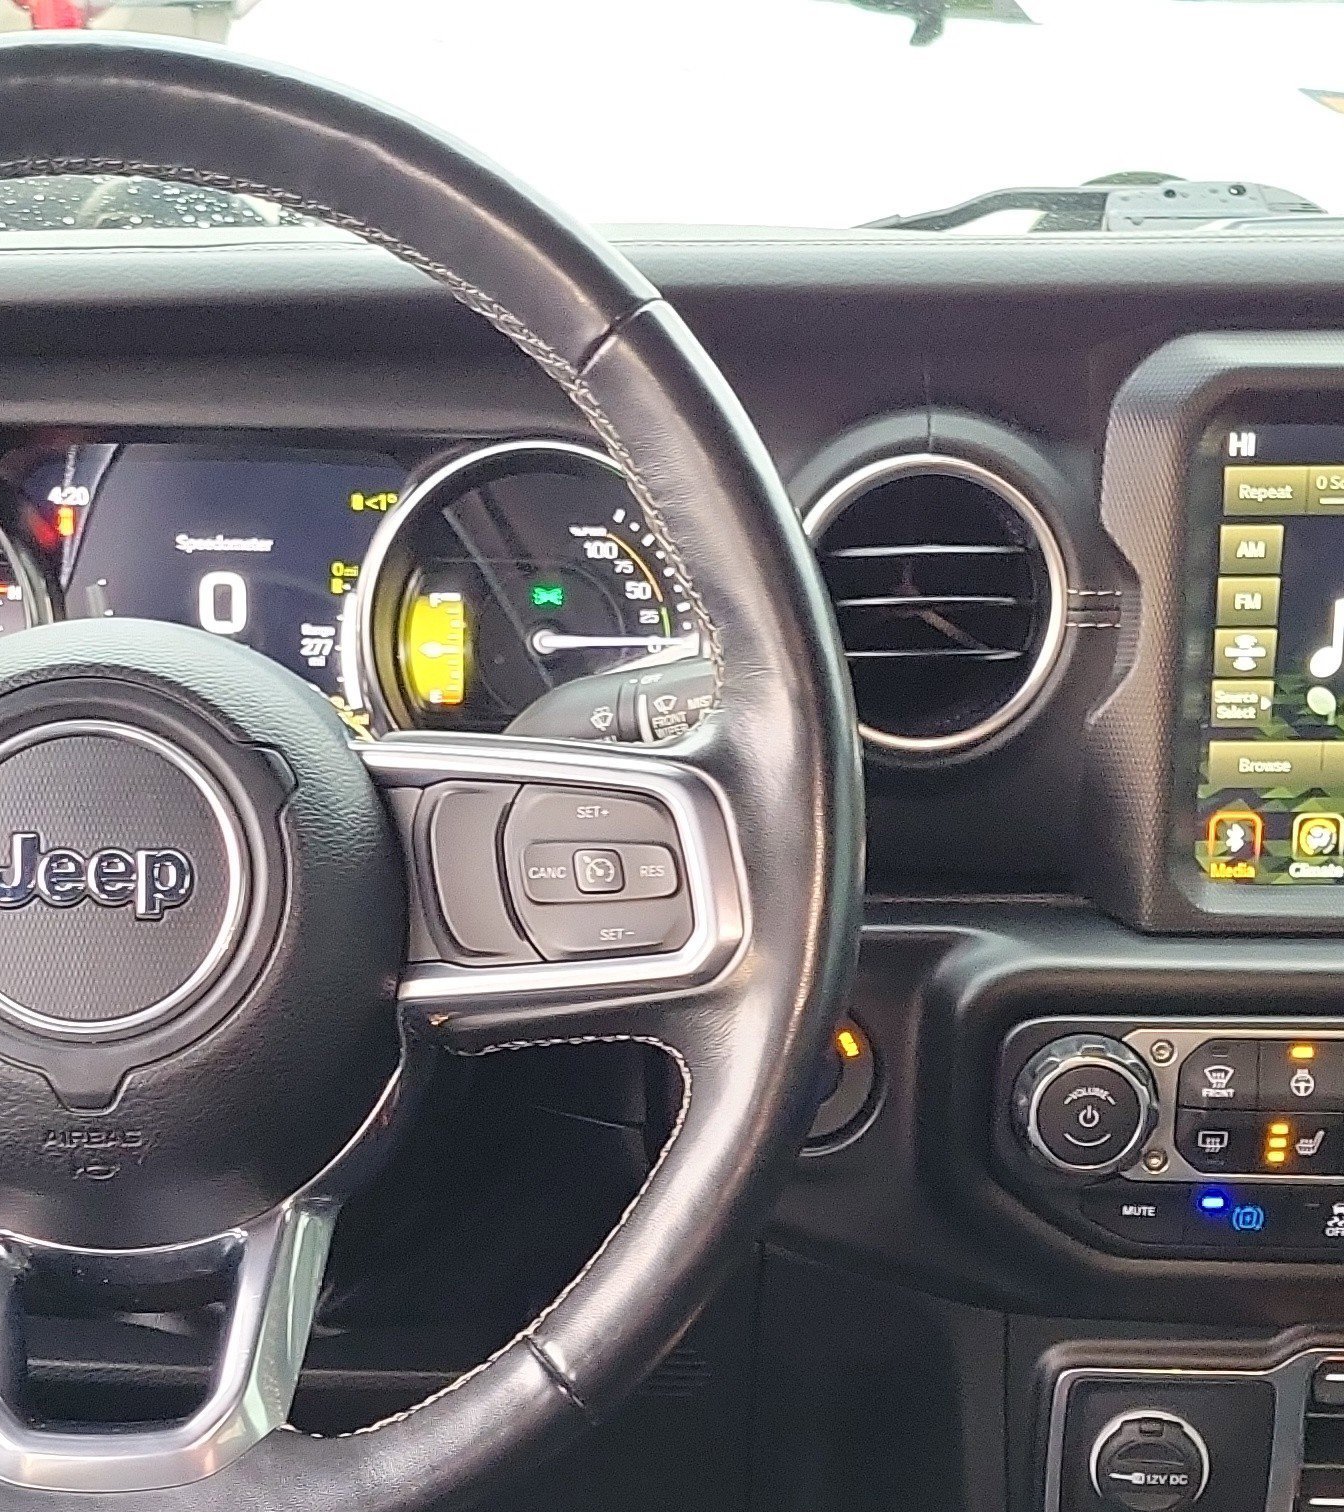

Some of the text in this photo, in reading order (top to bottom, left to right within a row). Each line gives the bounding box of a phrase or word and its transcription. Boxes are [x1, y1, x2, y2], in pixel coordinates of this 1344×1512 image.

[1229, 432, 1256, 457] HI
[1316, 476, 1326, 489] 0
[1239, 484, 1293, 501] Repeat
[584, 541, 618, 559] 100
[1236, 541, 1265, 557] AM
[613, 559, 634, 574] 75
[625, 581, 652, 600] 50
[199, 571, 246, 634] 0
[1234, 592, 1262, 609] FM
[639, 608, 660, 624] 25
[1238, 757, 1292, 773] Browse
[528, 866, 567, 879] CANC
[639, 865, 665, 877] RES
[1211, 862, 1255, 878] Media
[1289, 862, 1344, 878] Climate
[1202, 1088, 1235, 1099] FRONT
[1122, 1205, 1156, 1217] MUTE
[1146, 1474, 1188, 1485] 12V DC
